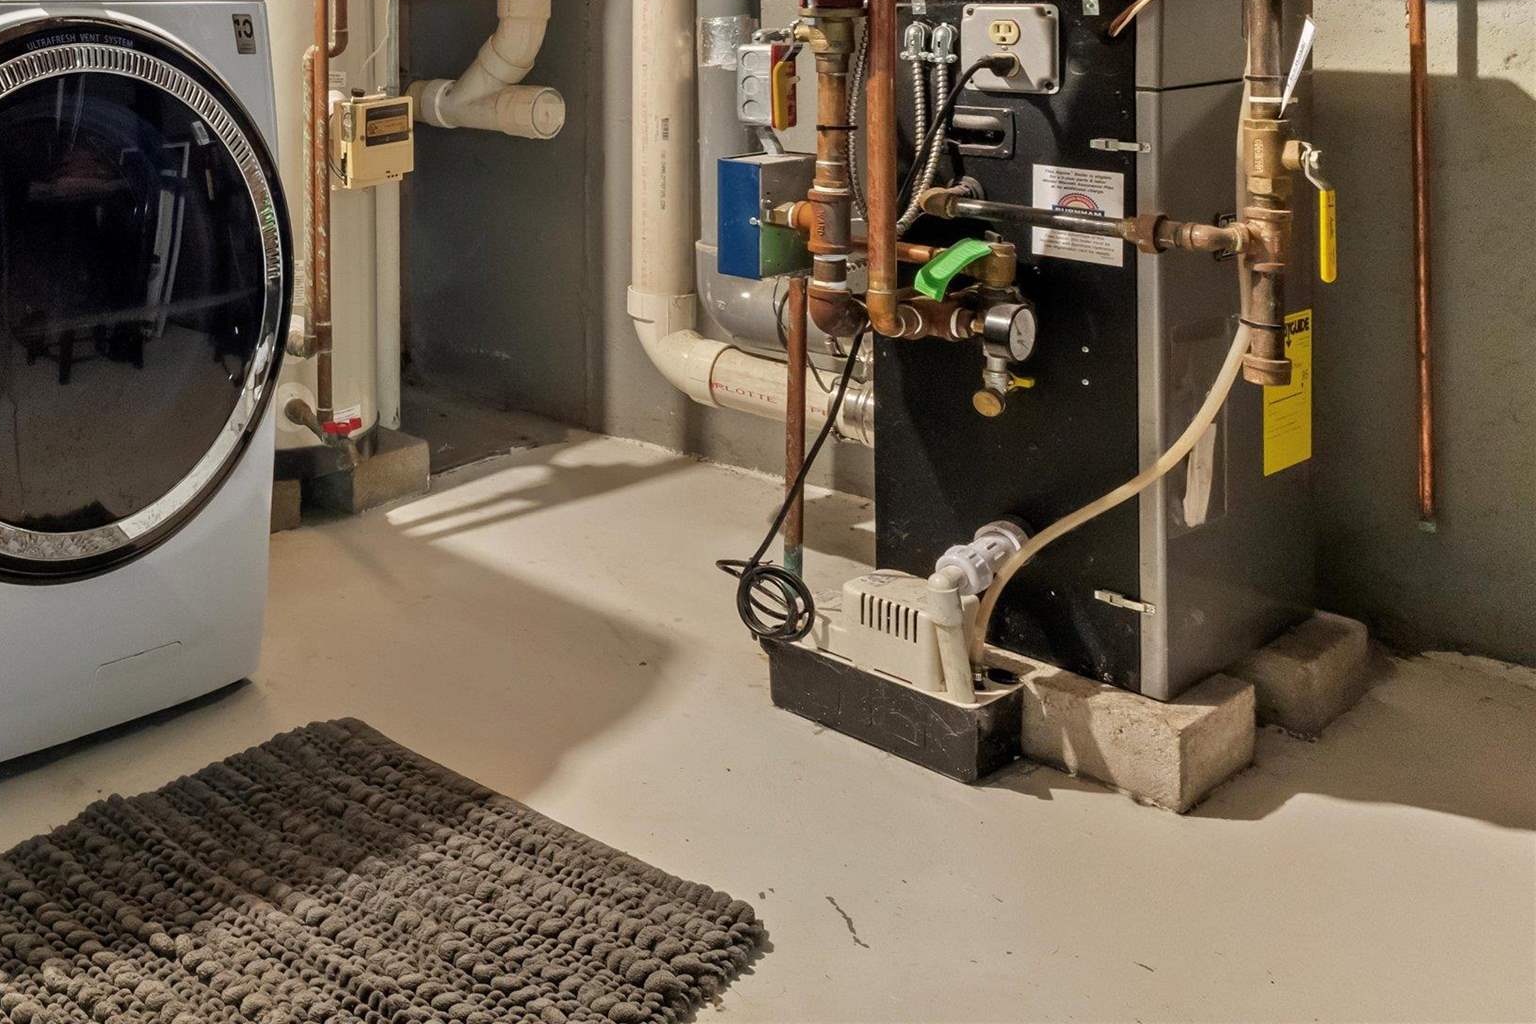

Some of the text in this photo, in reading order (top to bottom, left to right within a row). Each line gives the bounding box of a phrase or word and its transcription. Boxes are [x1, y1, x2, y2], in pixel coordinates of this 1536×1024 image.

[26, 33, 134, 50] ULTRAFRESH VENT SYSTEM
